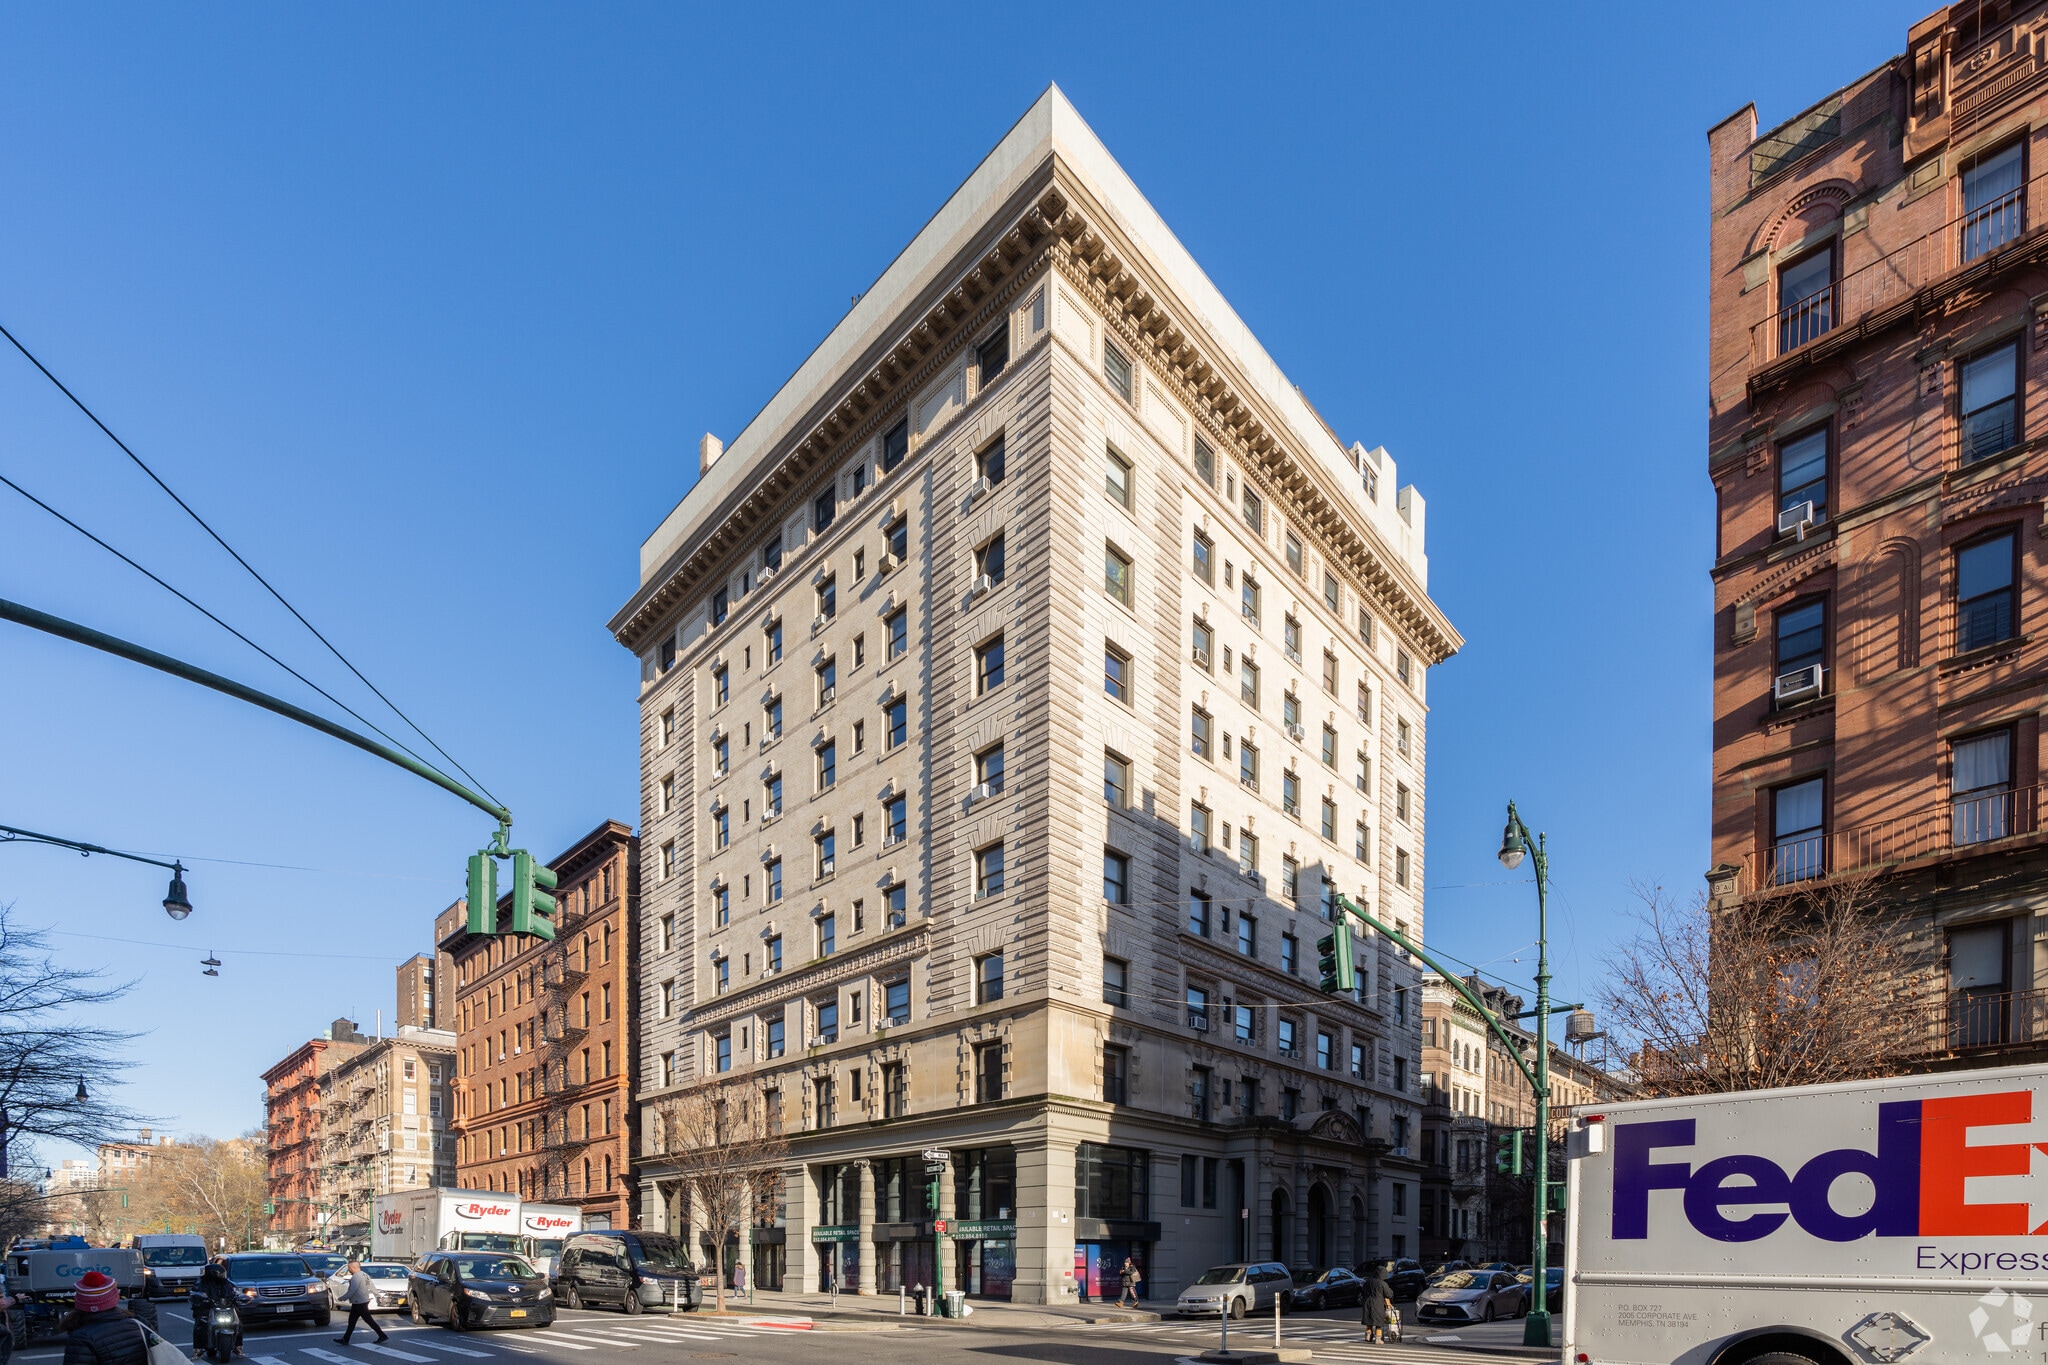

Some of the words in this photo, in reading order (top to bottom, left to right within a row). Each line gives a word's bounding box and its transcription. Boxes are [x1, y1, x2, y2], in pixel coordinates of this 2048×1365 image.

[1611, 1090, 2048, 1243] FedE
[468, 1203, 511, 1216] Ryder
[383, 1209, 402, 1229] Ryder
[537, 1216, 573, 1228] Ryder
[1636, 1312, 1681, 1320] CORPORATE
